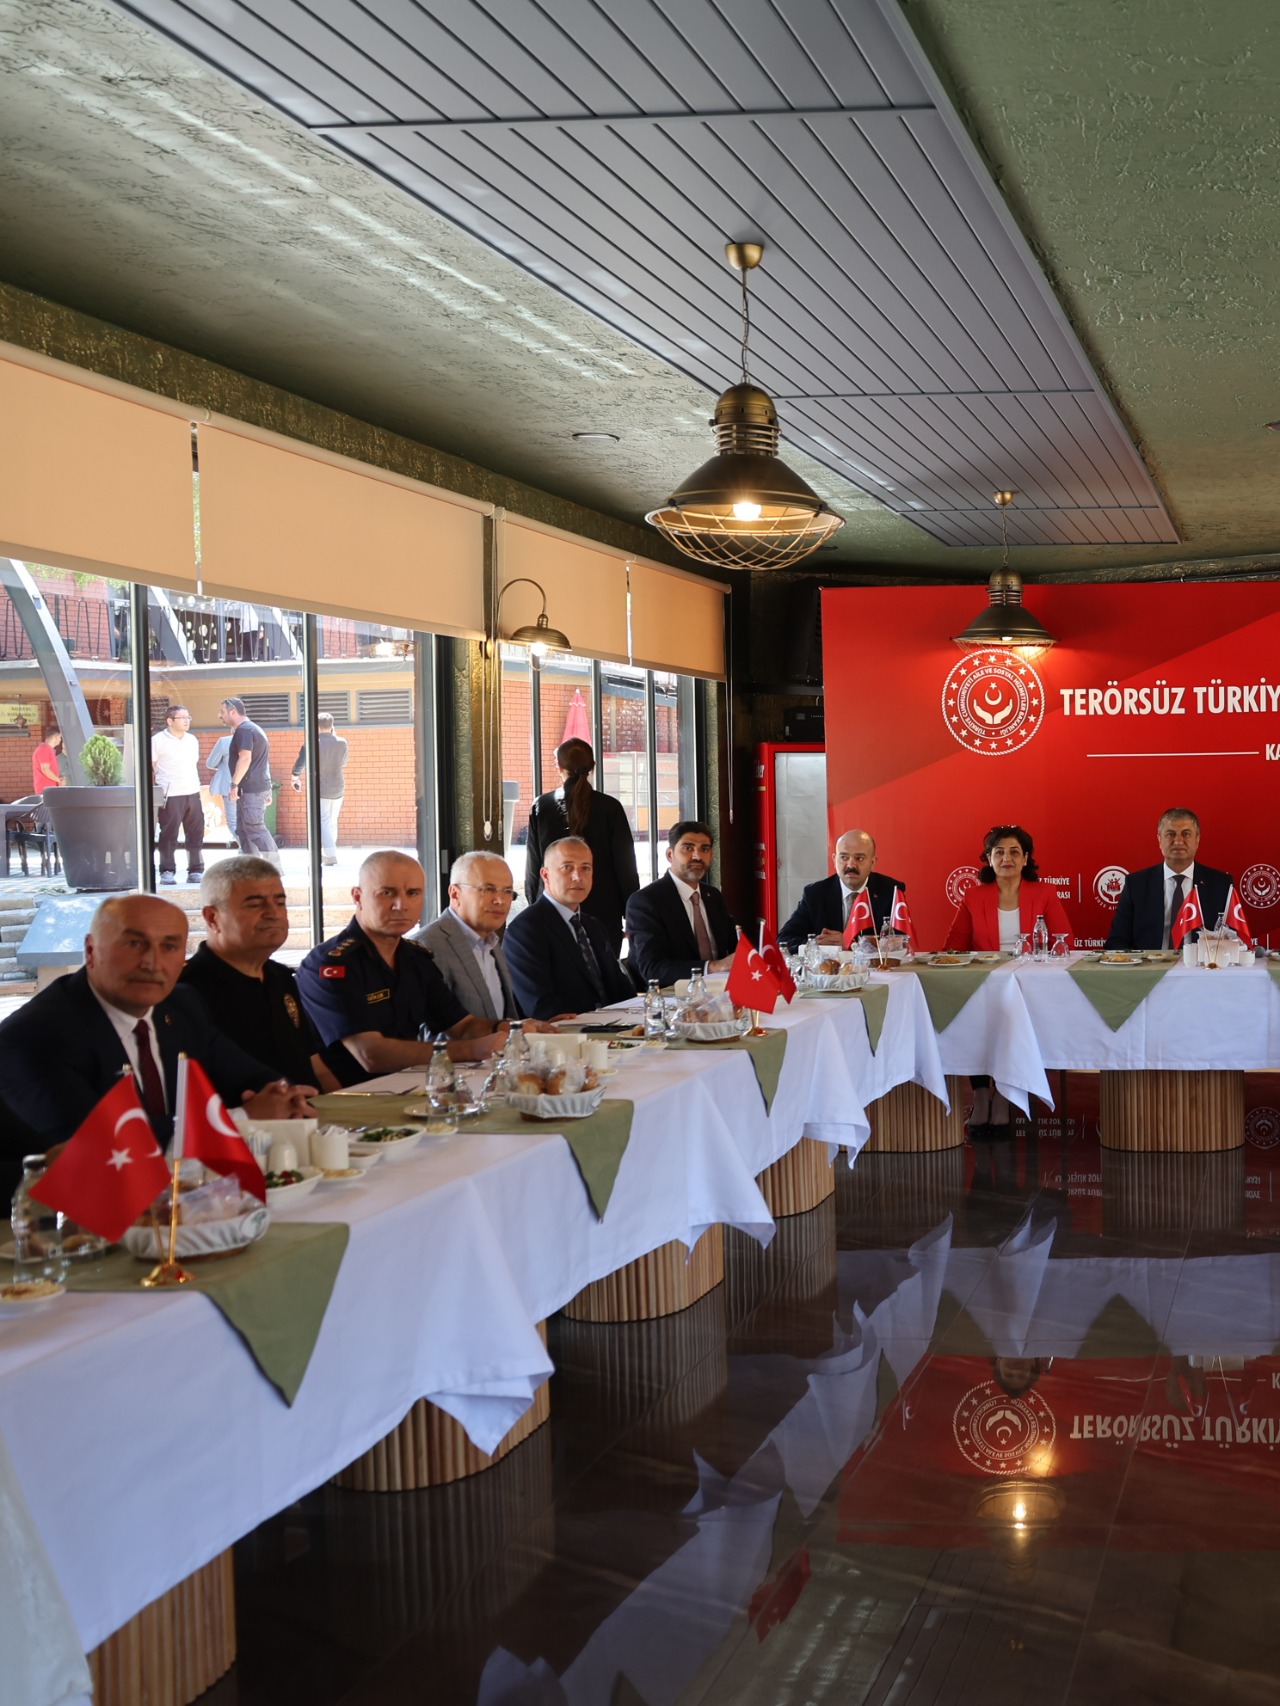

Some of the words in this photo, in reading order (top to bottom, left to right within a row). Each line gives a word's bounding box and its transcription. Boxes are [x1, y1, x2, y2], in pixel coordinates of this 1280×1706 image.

[972, 669, 985, 679] AİLE
[993, 668, 1014, 680] SOSYAL
[1060, 681, 1185, 715] TERÖRSÜZ
